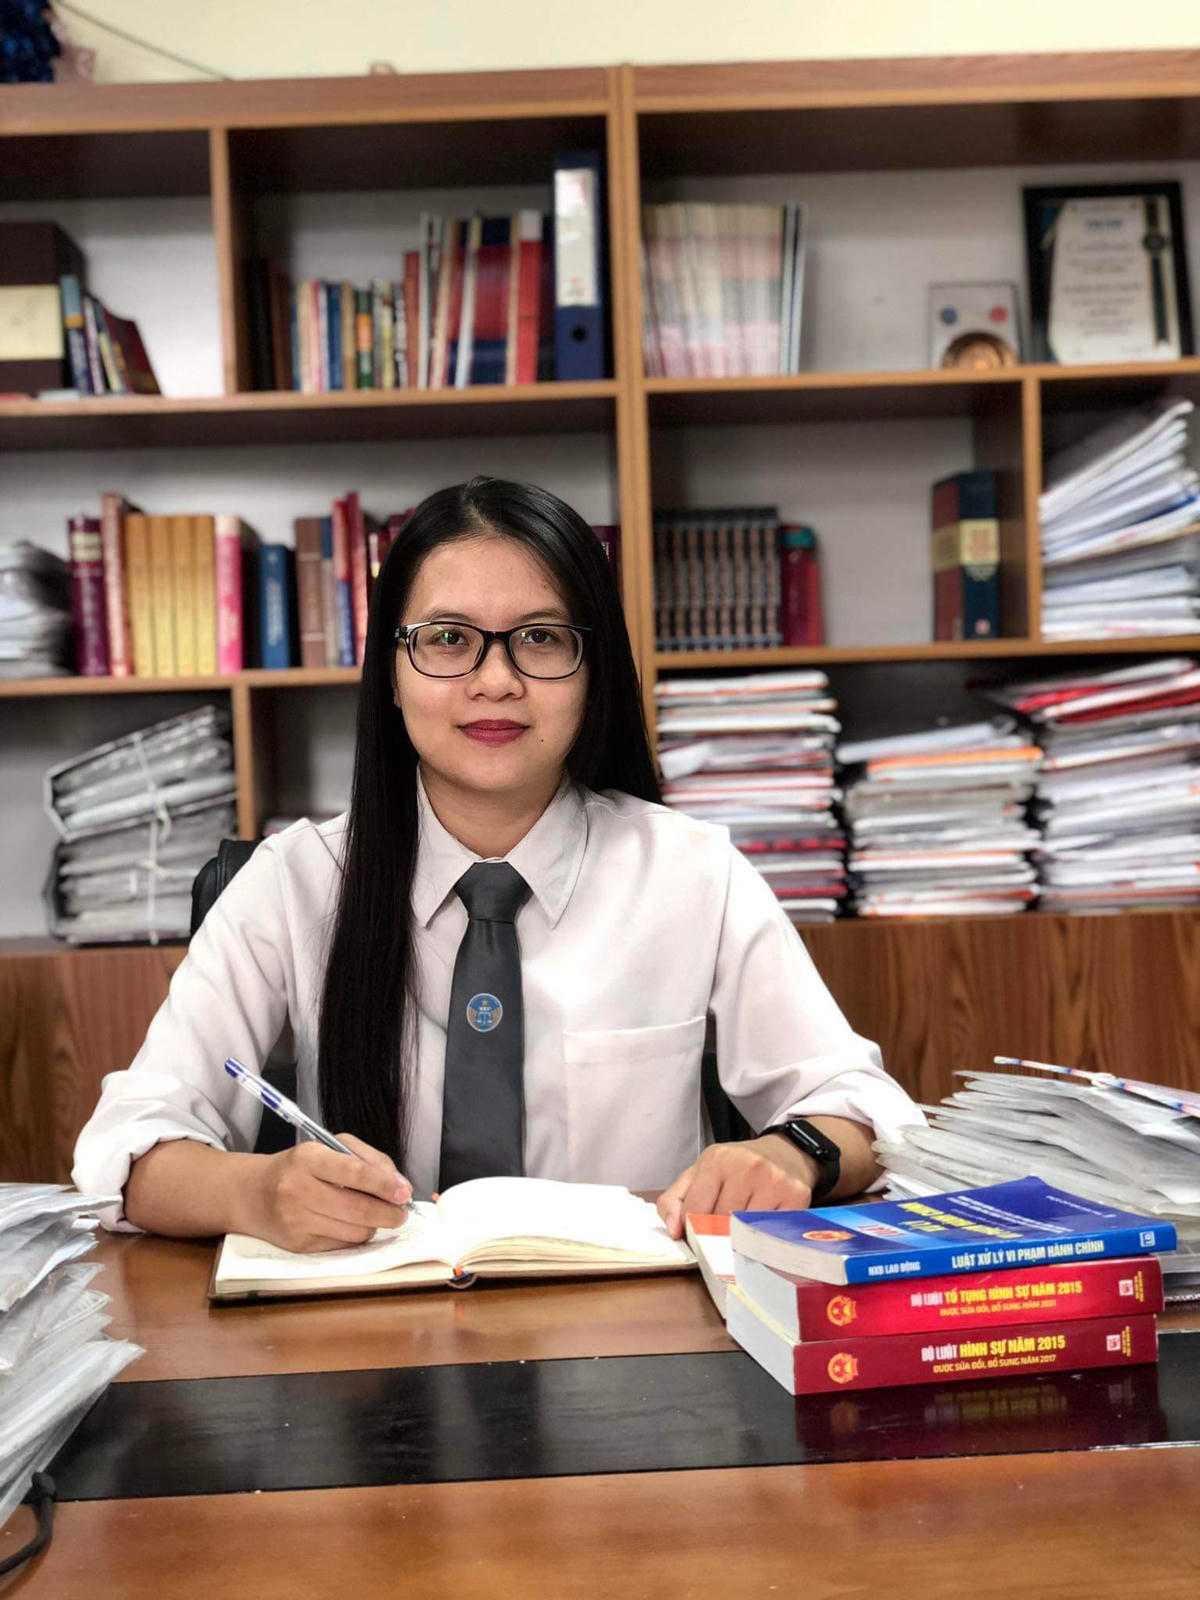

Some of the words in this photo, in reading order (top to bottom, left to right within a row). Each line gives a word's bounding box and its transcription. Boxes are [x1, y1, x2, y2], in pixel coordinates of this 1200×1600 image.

[951, 1252, 975, 1270] LUẬT
[977, 1247, 992, 1266] XỬ
[993, 1248, 1004, 1264] LÝ
[1006, 1249, 1016, 1262] VI
[1017, 1246, 1045, 1262] PHẠM
[1047, 1242, 1074, 1258] HÀNH
[1075, 1239, 1104, 1255] CHÍNH
[868, 1265, 884, 1277] NXB
[885, 1263, 899, 1275] LAO
[944, 1287, 958, 1304] TỐ
[960, 1288, 987, 1305] TỤNG
[988, 1285, 1014, 1300] HÌNH
[1015, 1283, 1030, 1300] SỰ
[1031, 1281, 1056, 1297] NĂM
[1057, 1280, 1082, 1296] 2015
[921, 1345, 935, 1362] BỘ
[935, 1343, 958, 1360] LUẬT
[959, 1341, 988, 1358] HÌNH
[990, 1339, 1006, 1357] SỰ
[1008, 1336, 1035, 1353] NĂM
[1037, 1335, 1066, 1351] 2015
[999, 1357, 1020, 1367] SUNG
[1020, 1354, 1039, 1365] NĂM
[1040, 1354, 1057, 1363] 2017
